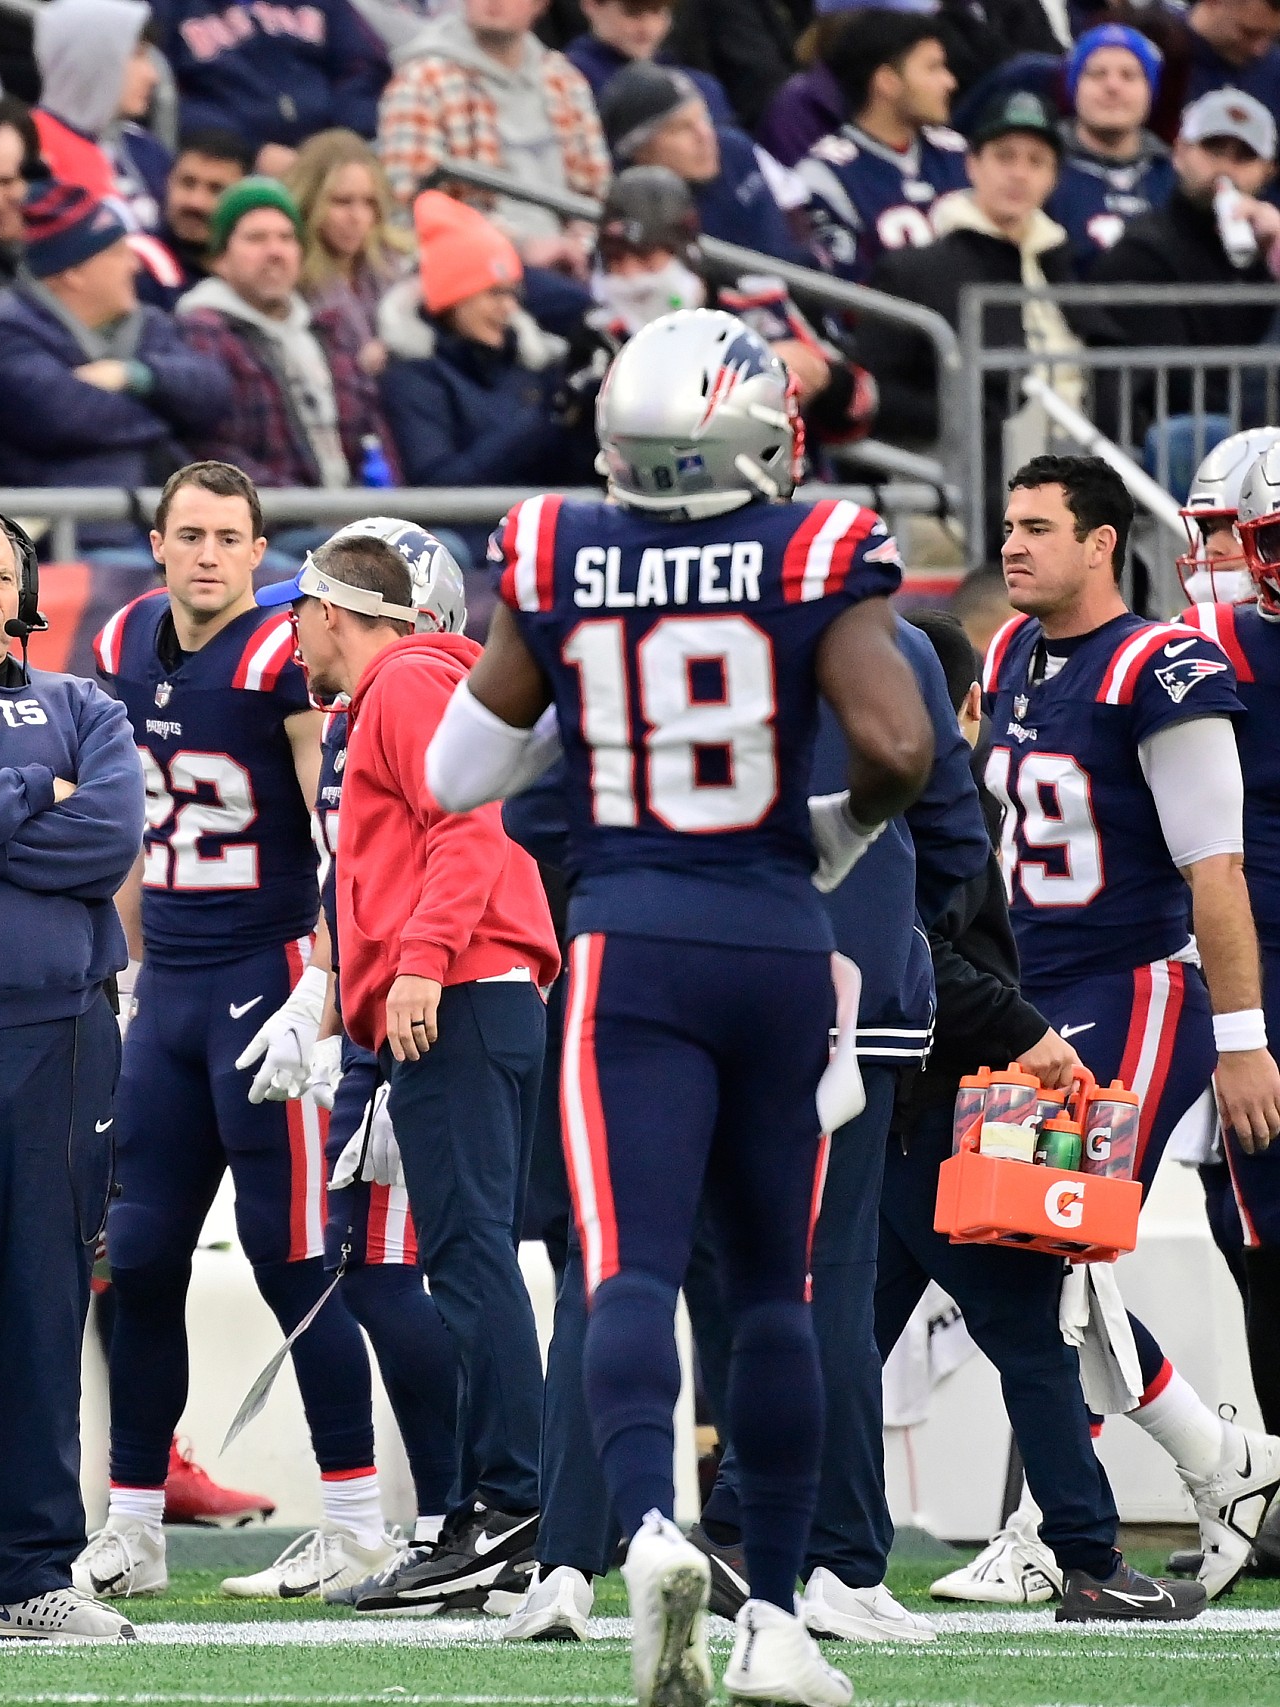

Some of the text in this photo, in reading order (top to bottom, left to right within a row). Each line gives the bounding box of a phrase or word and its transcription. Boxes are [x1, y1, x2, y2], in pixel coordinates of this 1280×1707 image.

[573, 541, 763, 608] SLATER
[146, 719, 182, 738] PATRIOTS
[562, 613, 778, 834] 18
[1044, 1180, 1086, 1229] G
